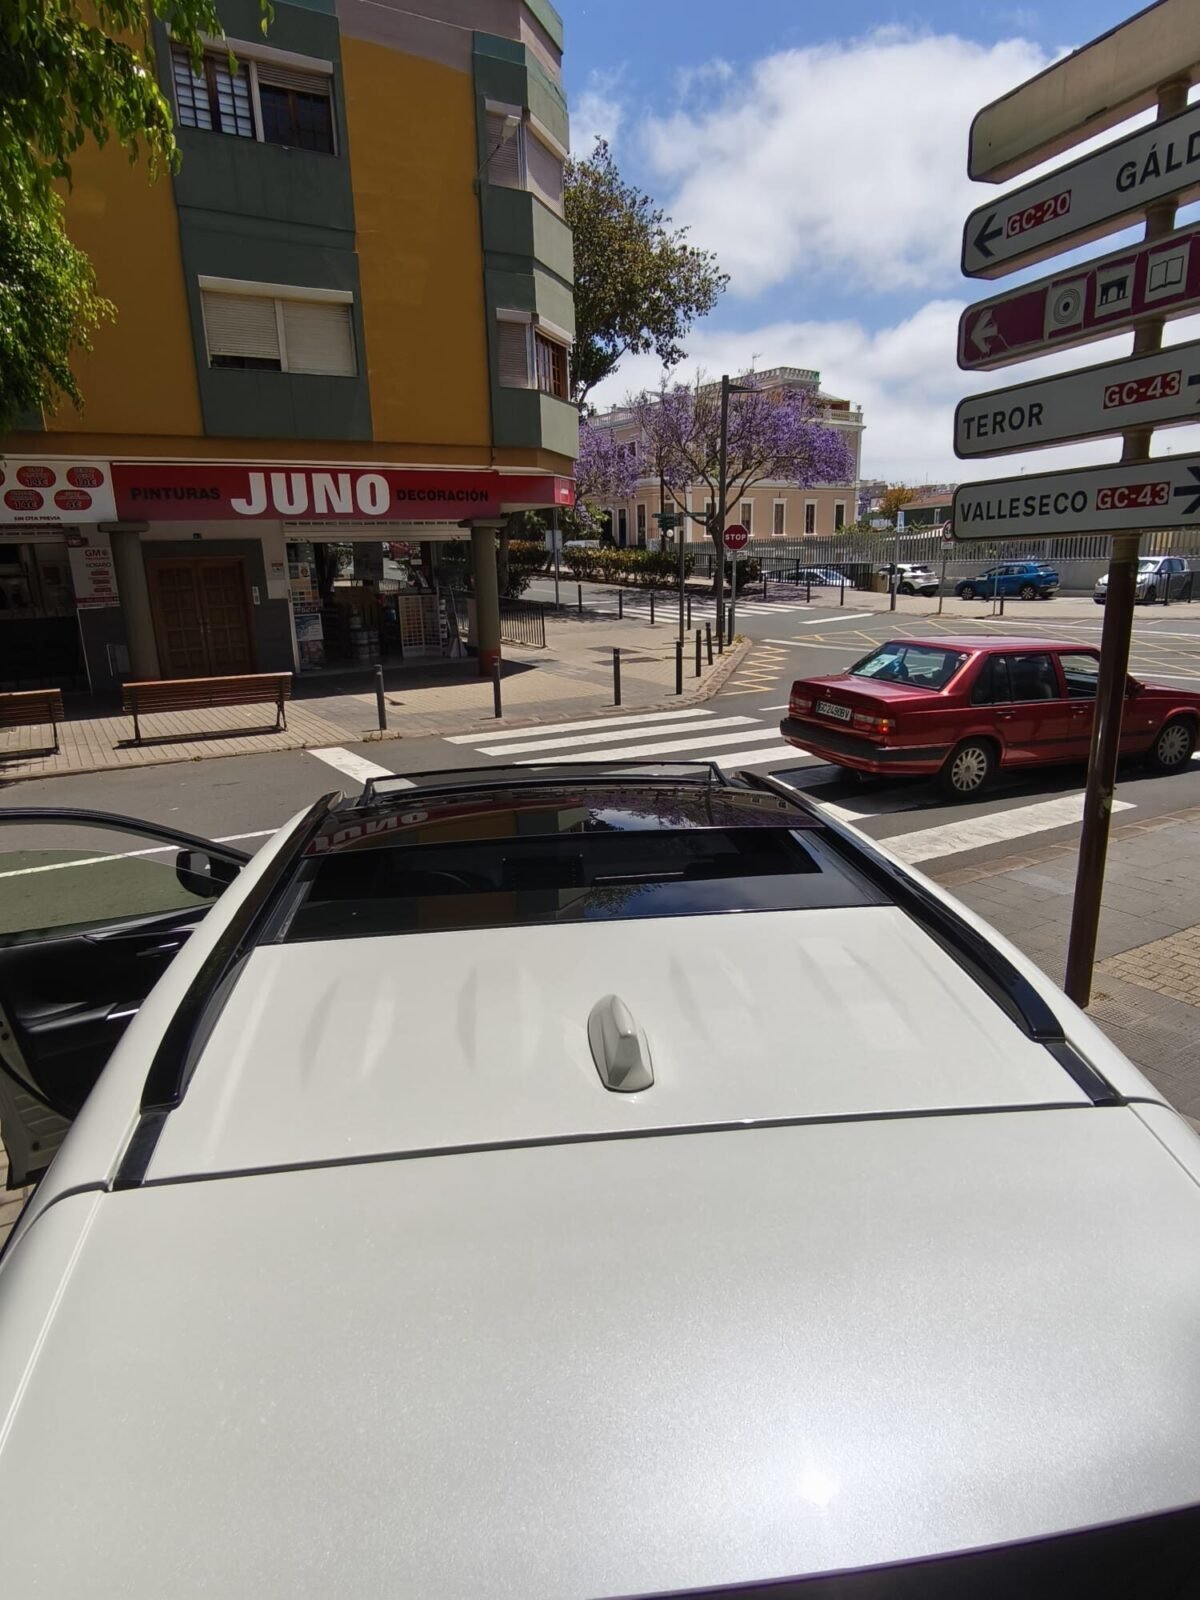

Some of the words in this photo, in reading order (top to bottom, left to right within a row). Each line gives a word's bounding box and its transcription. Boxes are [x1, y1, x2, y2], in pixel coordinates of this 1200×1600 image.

[1007, 191, 1071, 237] GC-20
[963, 402, 1044, 440] TEROR
[1105, 371, 1181, 408] GC-43
[130, 487, 221, 500] PINTURAS
[231, 472, 391, 515] JUNO
[396, 487, 490, 502] DECORACIÓN
[960, 490, 1088, 523] VALLESECO
[1098, 483, 1169, 510] GC-43
[724, 533, 747, 541] STOP
